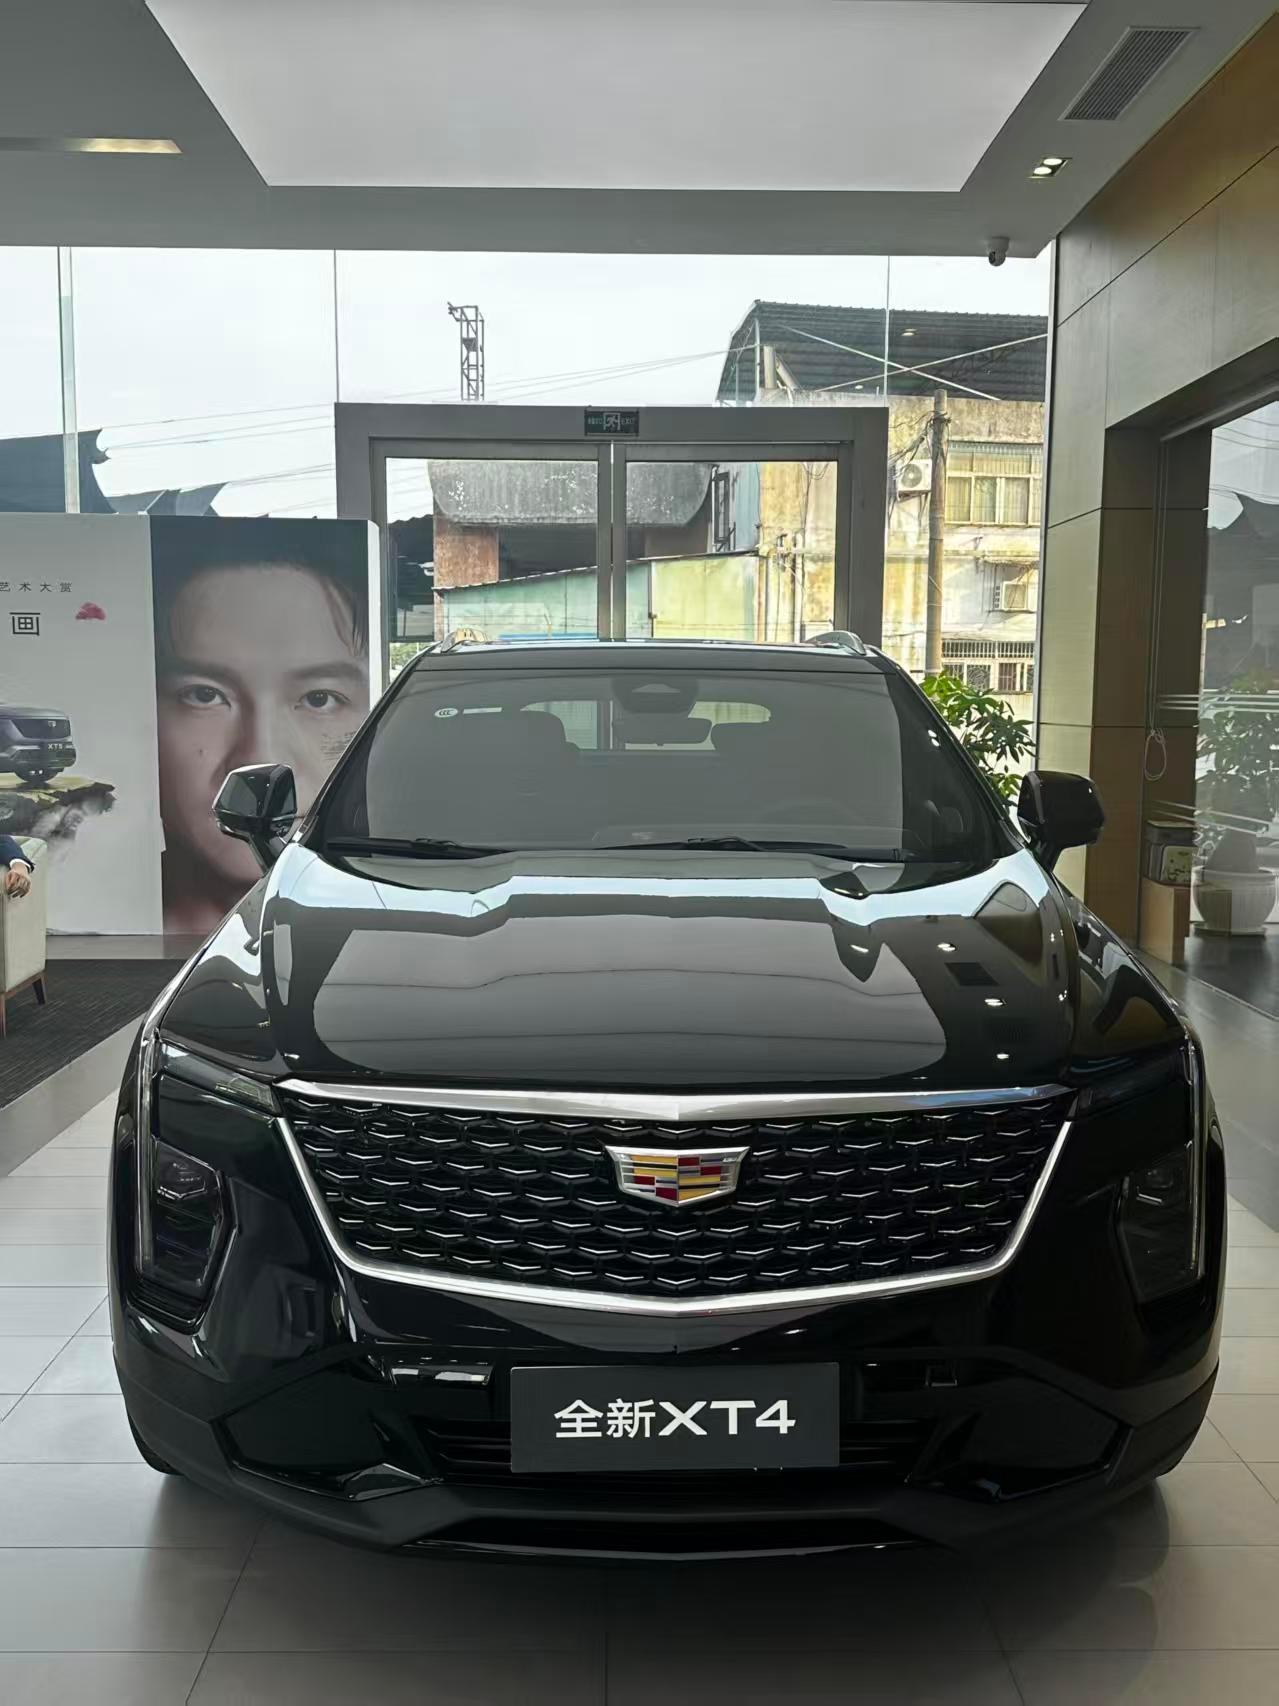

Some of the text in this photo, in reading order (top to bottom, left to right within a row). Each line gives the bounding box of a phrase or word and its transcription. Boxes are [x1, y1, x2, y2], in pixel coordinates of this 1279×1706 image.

[0, 582, 72, 593] 艺术大赏
[9, 612, 41, 636] 画
[553, 1398, 797, 1438] 全新XT4
